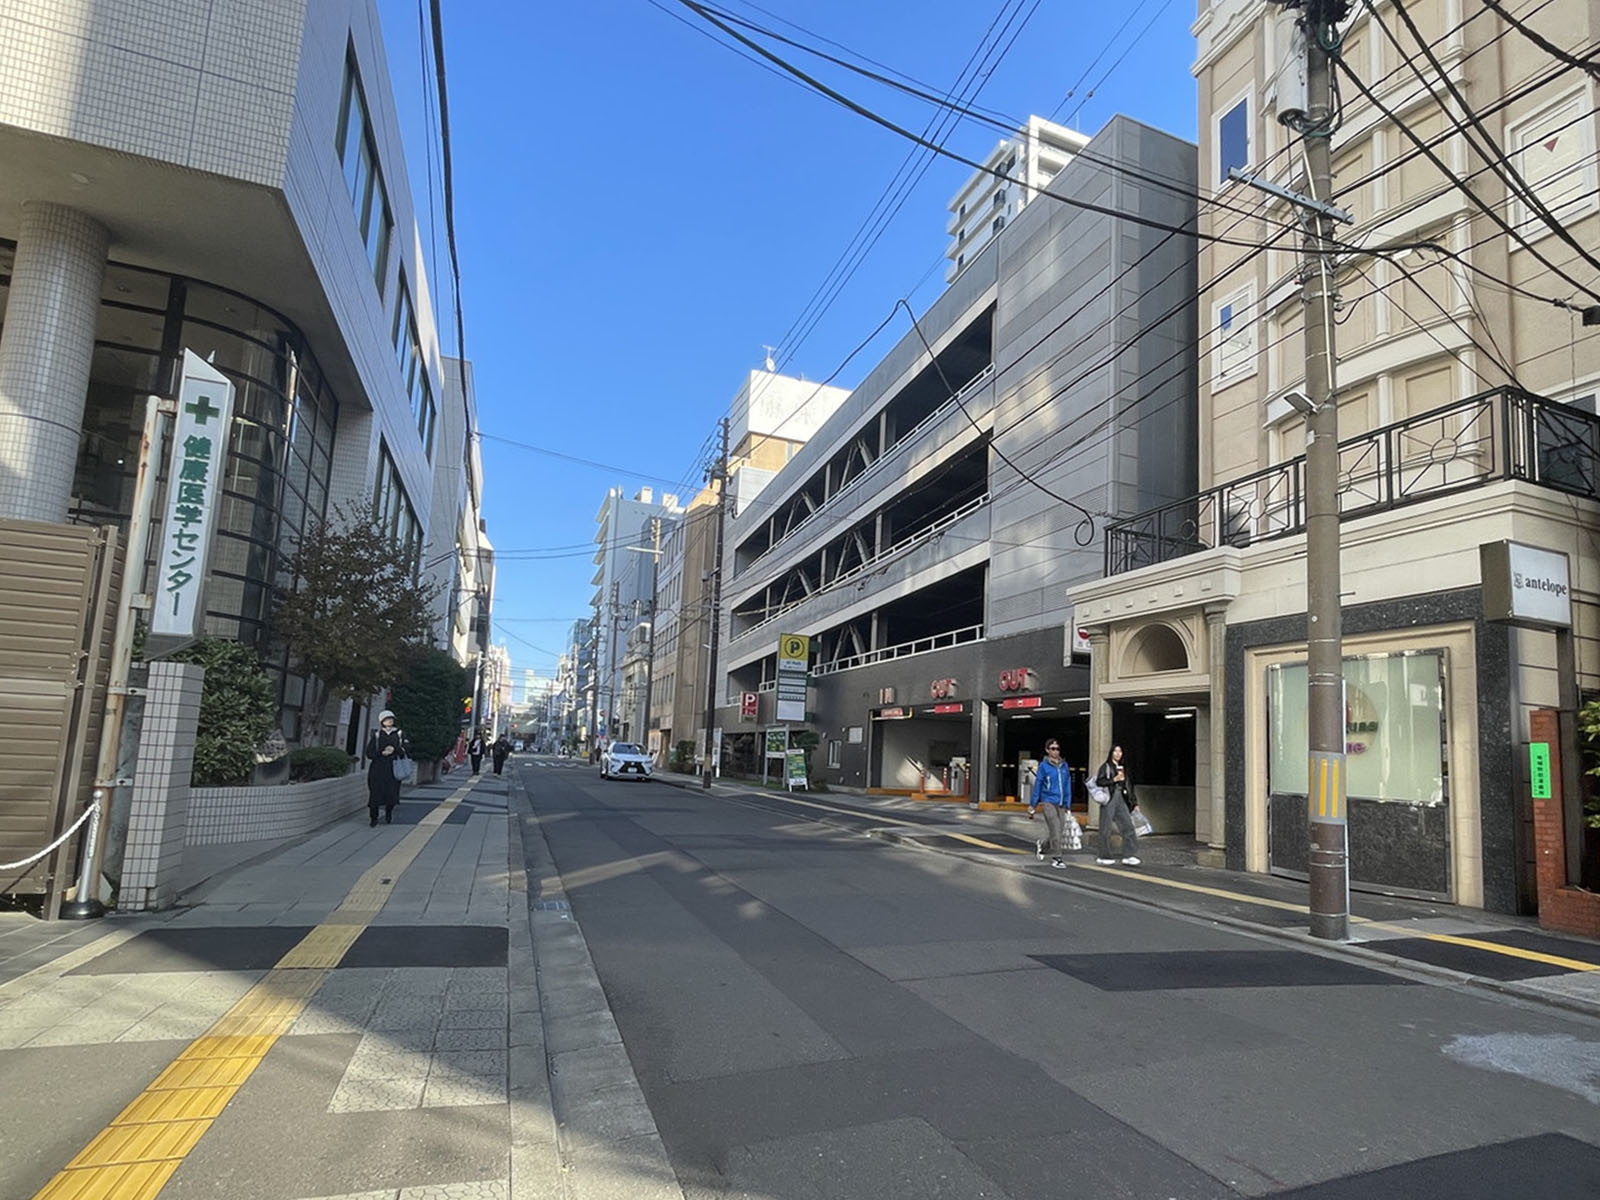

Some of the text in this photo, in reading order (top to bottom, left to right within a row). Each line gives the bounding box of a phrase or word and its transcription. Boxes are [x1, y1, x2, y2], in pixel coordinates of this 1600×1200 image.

[166, 434, 212, 616] 健康医学センター
[1525, 578, 1567, 597] antelope
[790, 641, 801, 654] P
[930, 678, 954, 699] OUT
[999, 667, 1031, 691] OUT
[745, 693, 756, 706] P
